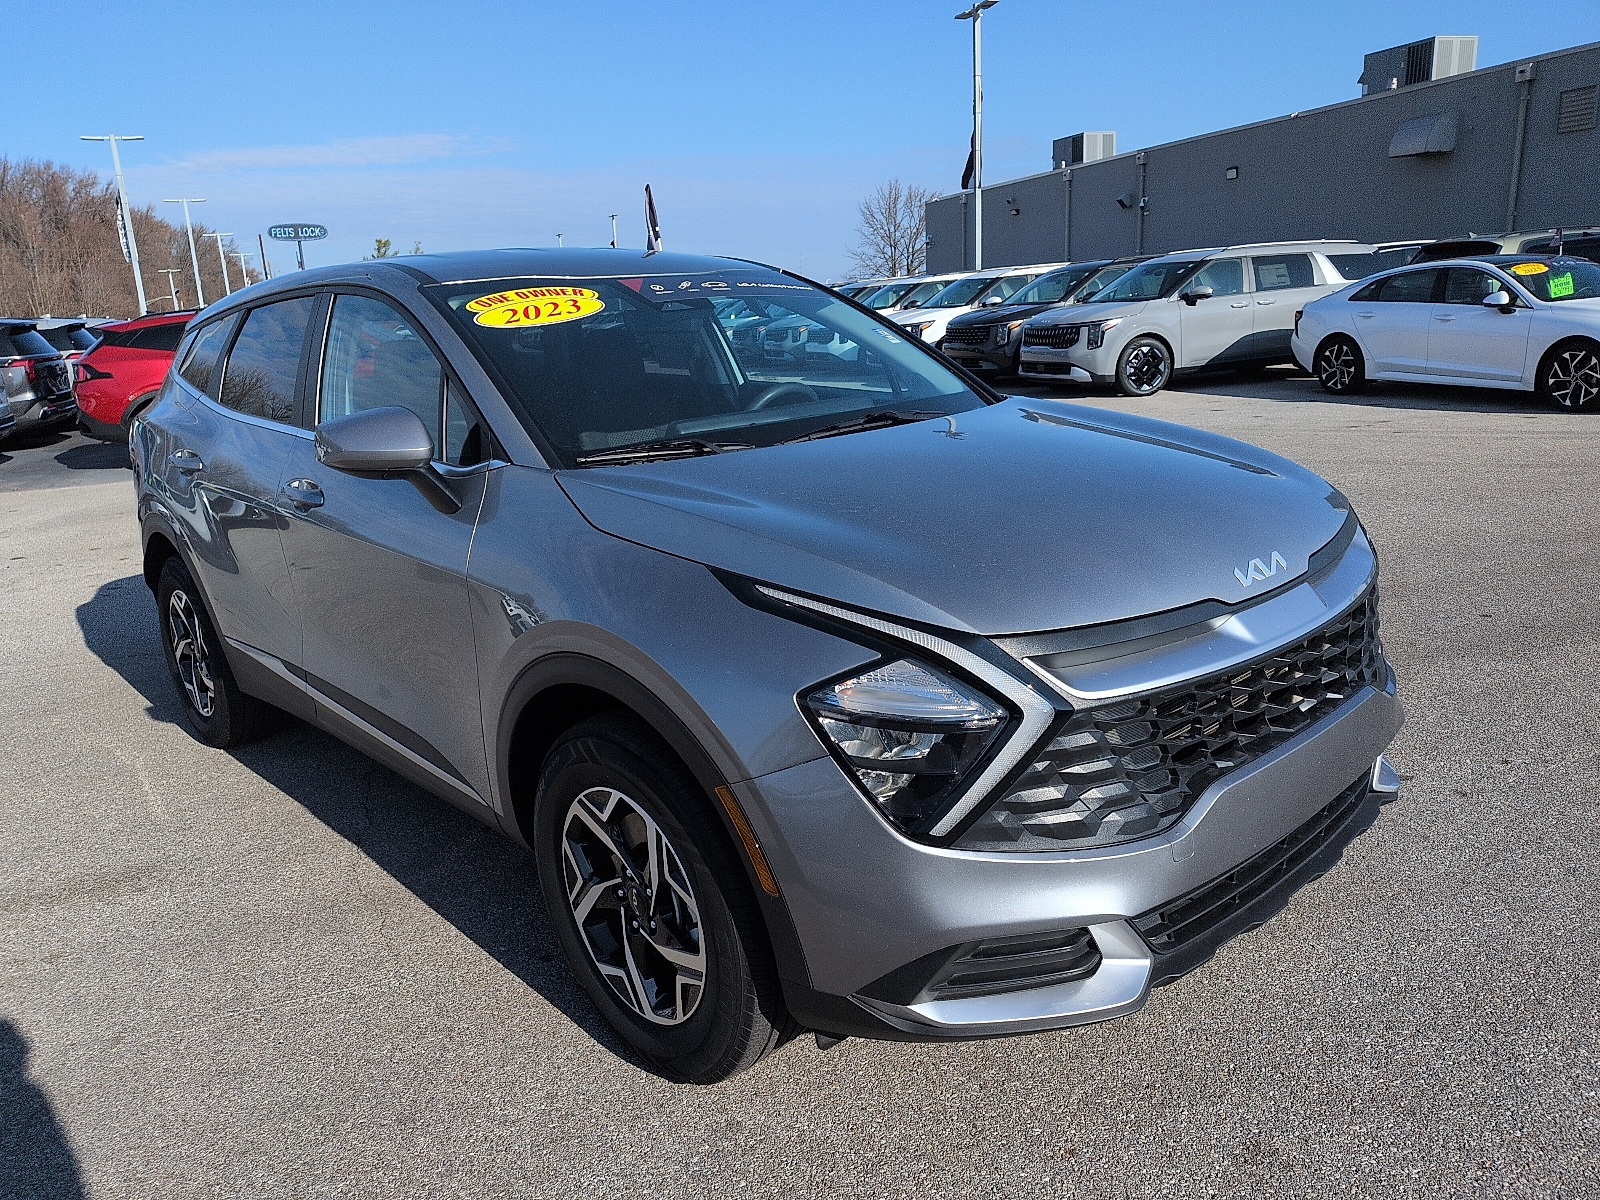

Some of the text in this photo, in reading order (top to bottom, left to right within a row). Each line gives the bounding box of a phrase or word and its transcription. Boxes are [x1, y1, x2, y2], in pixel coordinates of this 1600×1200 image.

[271, 227, 295, 238] FELTS
[298, 227, 320, 237] LOCK
[475, 288, 585, 308] ONE OWNER
[501, 298, 582, 325] 2023
[1233, 550, 1287, 588] KIA
